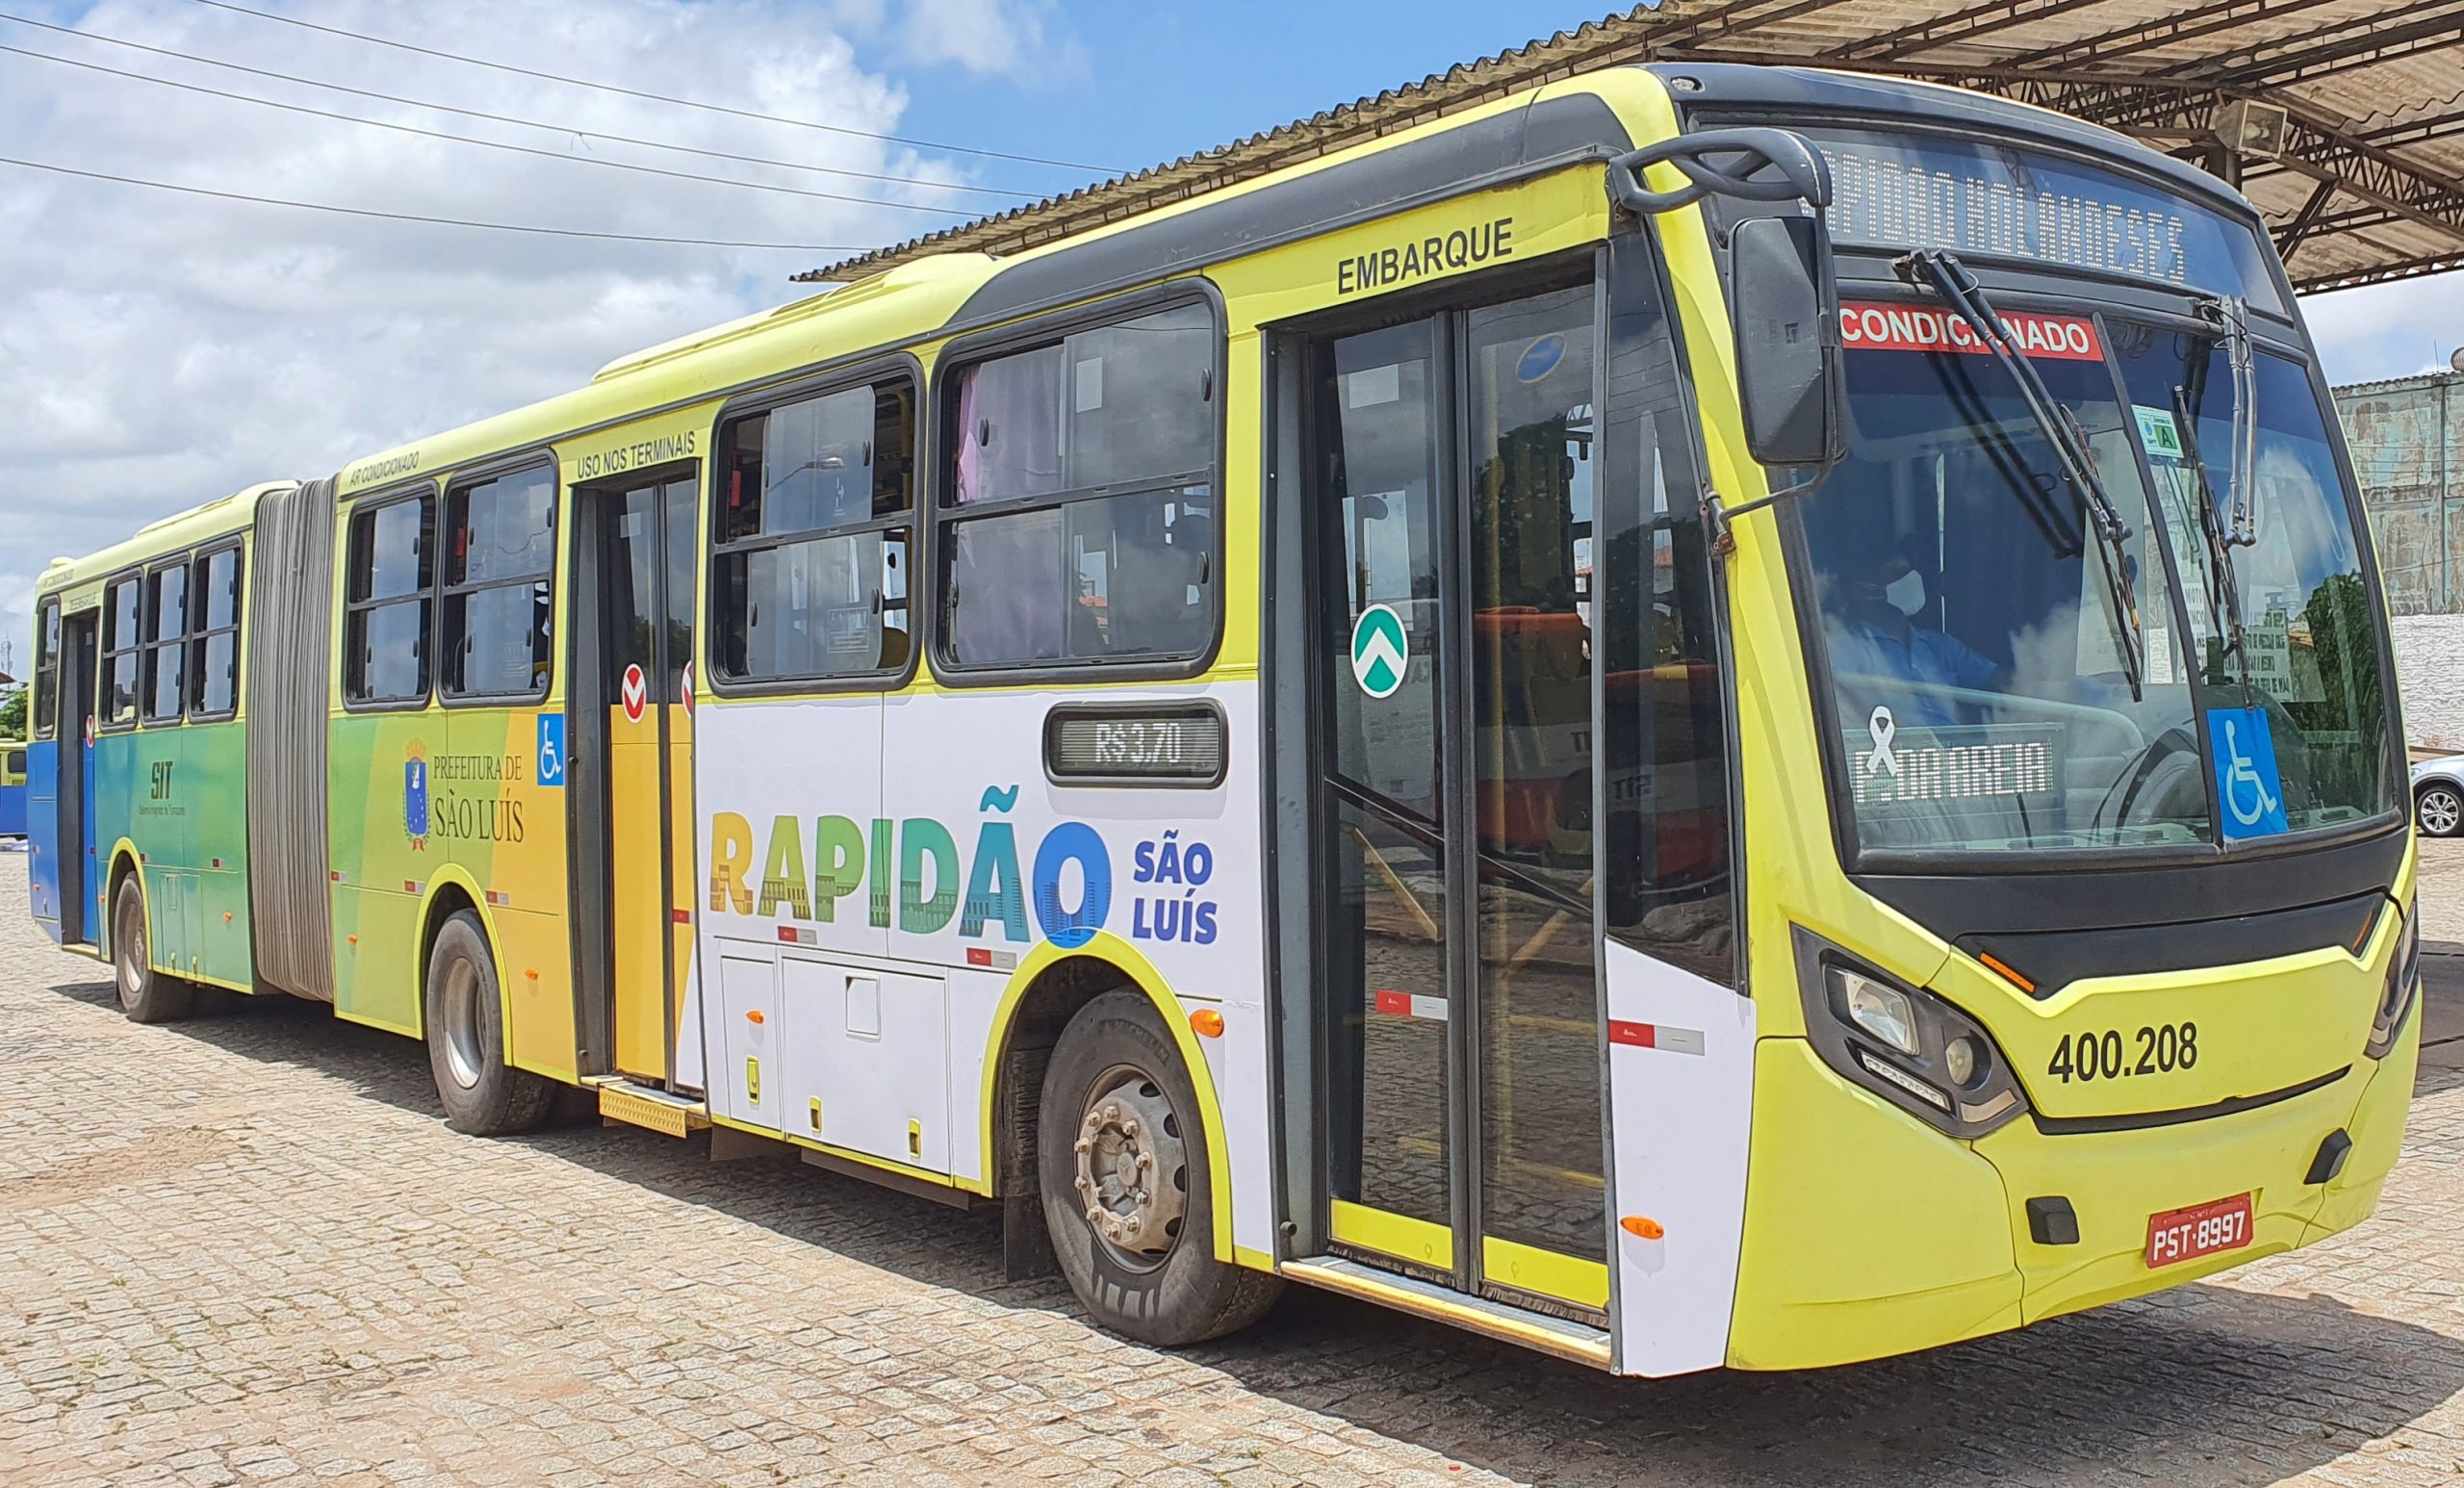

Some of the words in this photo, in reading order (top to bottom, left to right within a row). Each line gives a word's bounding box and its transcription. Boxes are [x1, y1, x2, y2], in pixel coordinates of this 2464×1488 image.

[1801, 149, 1956, 249] APIDAO
[1965, 176, 2185, 286] HOLANDESES
[1338, 217, 1513, 295] EMBARQUE
[1838, 307, 2091, 354] CONDICNADO
[578, 453, 601, 479] USO
[603, 447, 628, 474] NOS
[630, 430, 695, 468] TERMINAIS
[2161, 426, 2173, 448] A
[349, 468, 362, 487] AR
[361, 450, 420, 484] CONDICIONADO
[151, 760, 173, 800] SIT
[433, 755, 502, 781] PREFEITURA
[505, 755, 523, 781] DE
[1948, 742, 2046, 798] AREIA
[434, 787, 474, 840] SÃO
[477, 786, 525, 843] LUÍS
[709, 784, 1113, 949] RAPIDÃO
[1133, 829, 1214, 885] SÃO
[1132, 887, 1219, 945] LUÍS
[2047, 1021, 2198, 1085] 400.208
